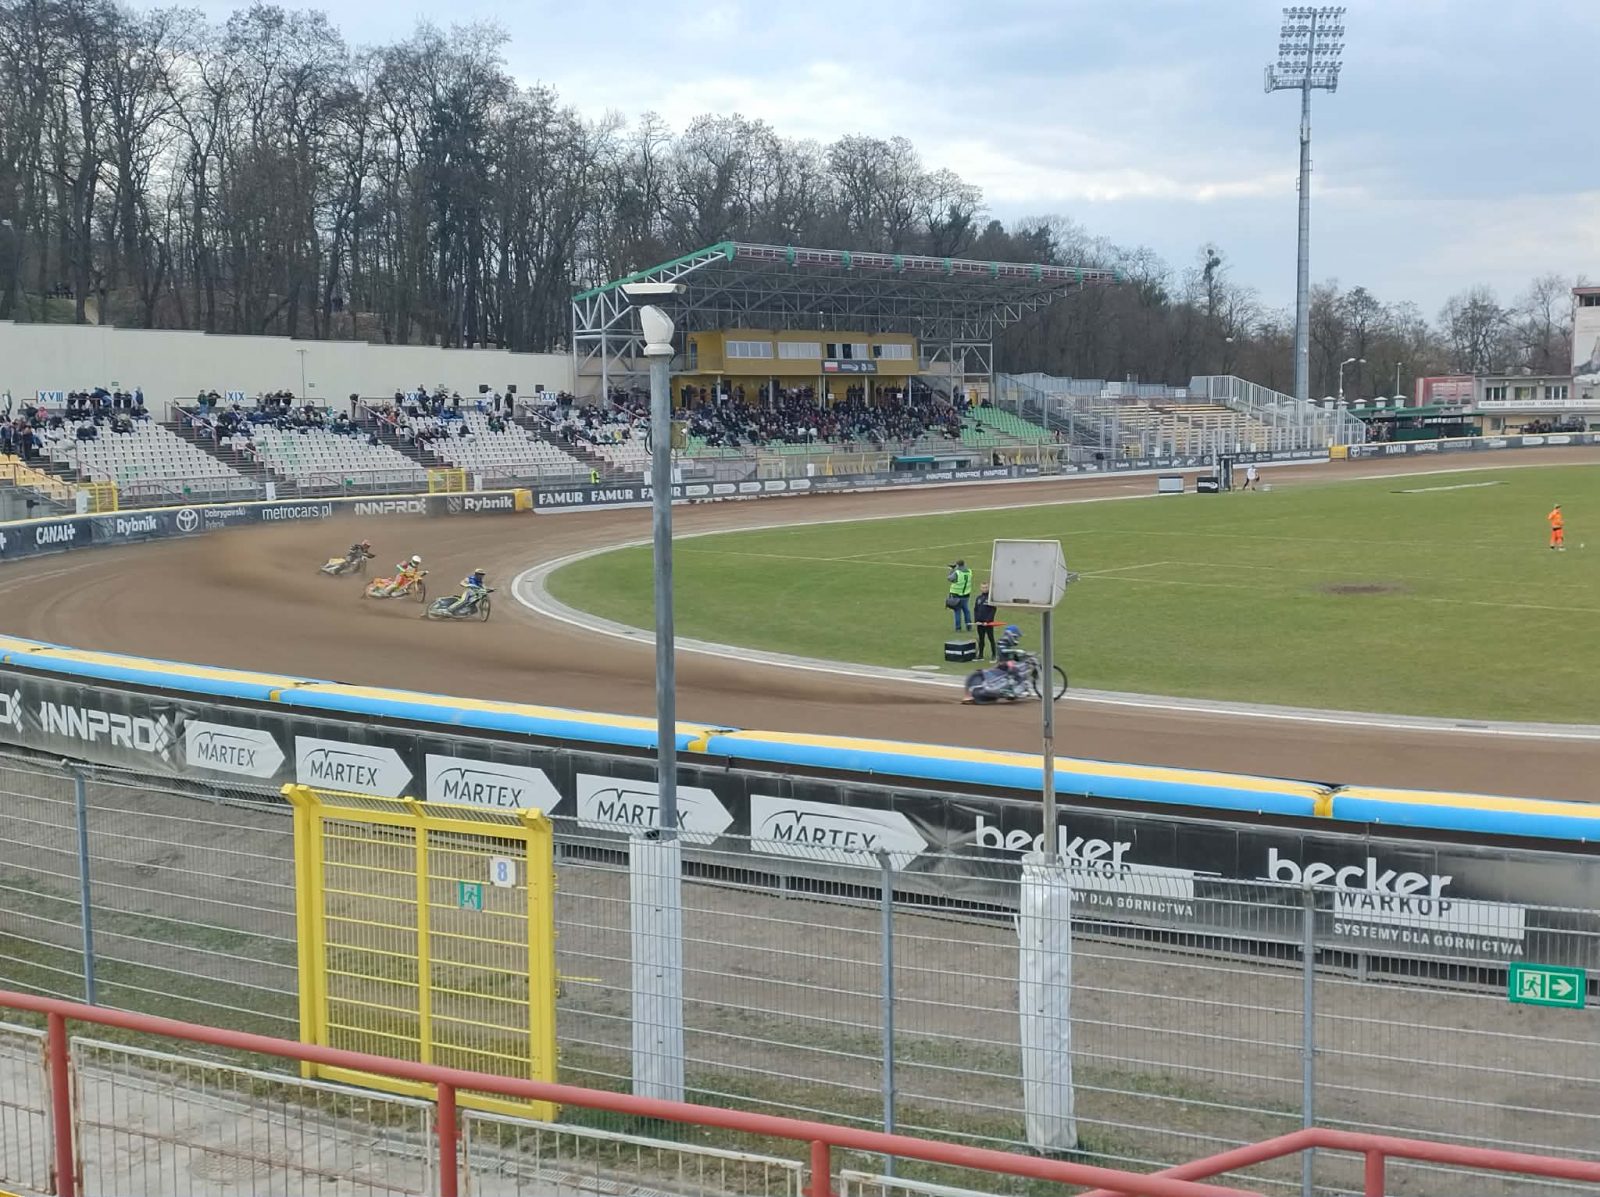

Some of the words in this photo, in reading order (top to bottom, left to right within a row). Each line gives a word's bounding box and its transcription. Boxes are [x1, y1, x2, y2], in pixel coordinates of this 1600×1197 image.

[227, 391, 245, 401] XIX
[464, 496, 513, 512] Rybnik
[538, 490, 584, 505] FAMUR
[591, 488, 634, 502] FAMUR
[640, 486, 681, 500] FAR
[262, 502, 332, 520] metrocars.pl
[116, 515, 157, 536] Rybnik
[198, 742, 256, 767] MARTEX
[310, 759, 378, 787] MARTEX
[443, 779, 523, 808] MARTEX
[597, 801, 689, 830] MARTX
[773, 823, 877, 854] MARTEX
[497, 861, 508, 882] 8
[1268, 847, 1453, 899] becker
[1090, 893, 1113, 907] DLA
[1117, 894, 1194, 917] GÓRNICTWA
[1338, 891, 1453, 918] WARKOP
[1334, 922, 1398, 941] SYSTEMY
[1402, 929, 1430, 945] DLA
[1434, 934, 1524, 956] GÓRNICTWA
